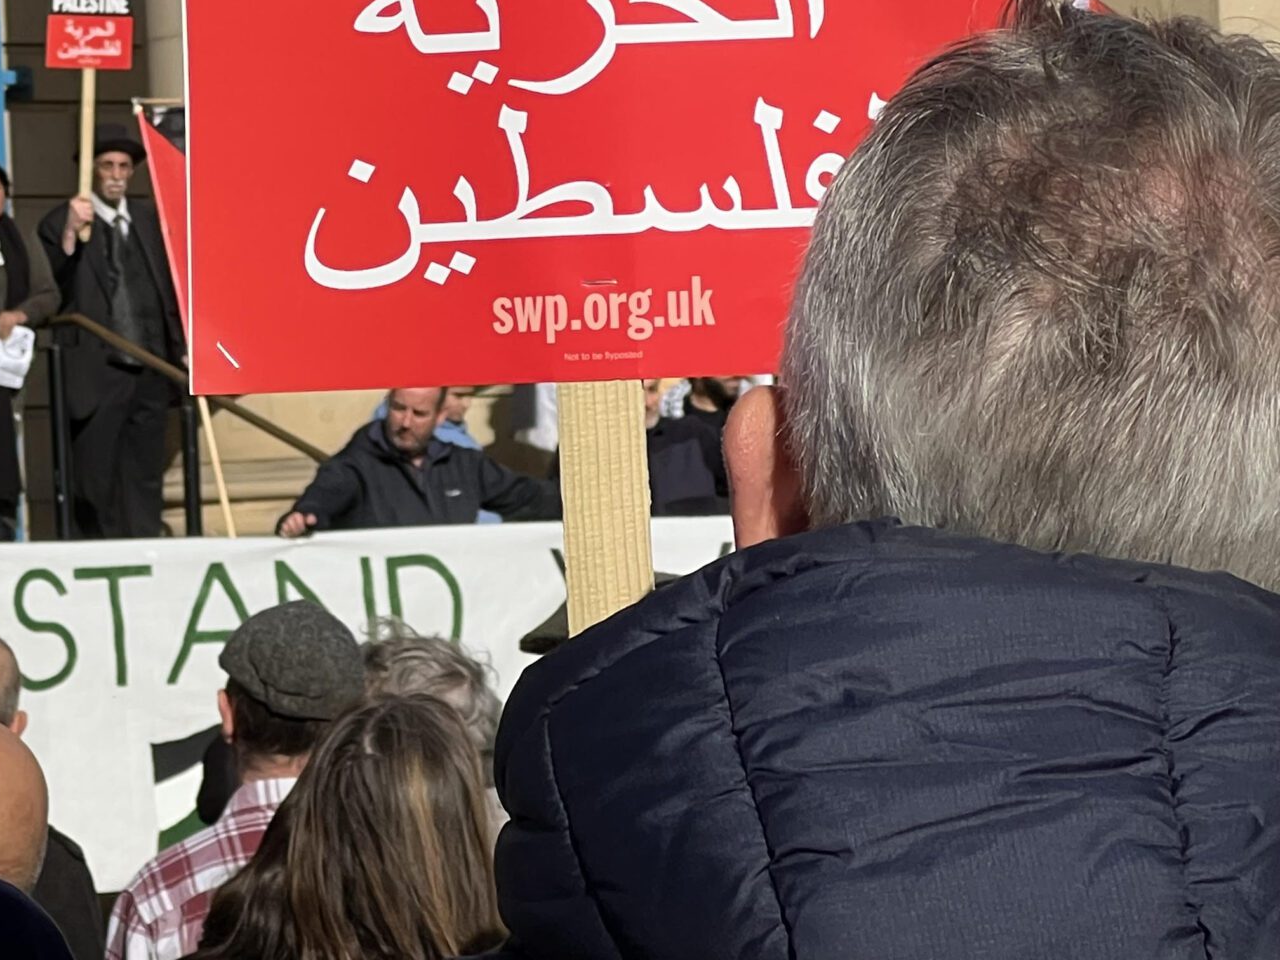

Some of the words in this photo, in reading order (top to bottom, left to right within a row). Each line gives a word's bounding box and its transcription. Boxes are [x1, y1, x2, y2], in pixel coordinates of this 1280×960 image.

[304, 92, 890, 290] فلسطين
[492, 276, 716, 344] swp.org.uk
[563, 352, 580, 361] Not
[581, 352, 591, 361] to
[592, 352, 603, 360] be
